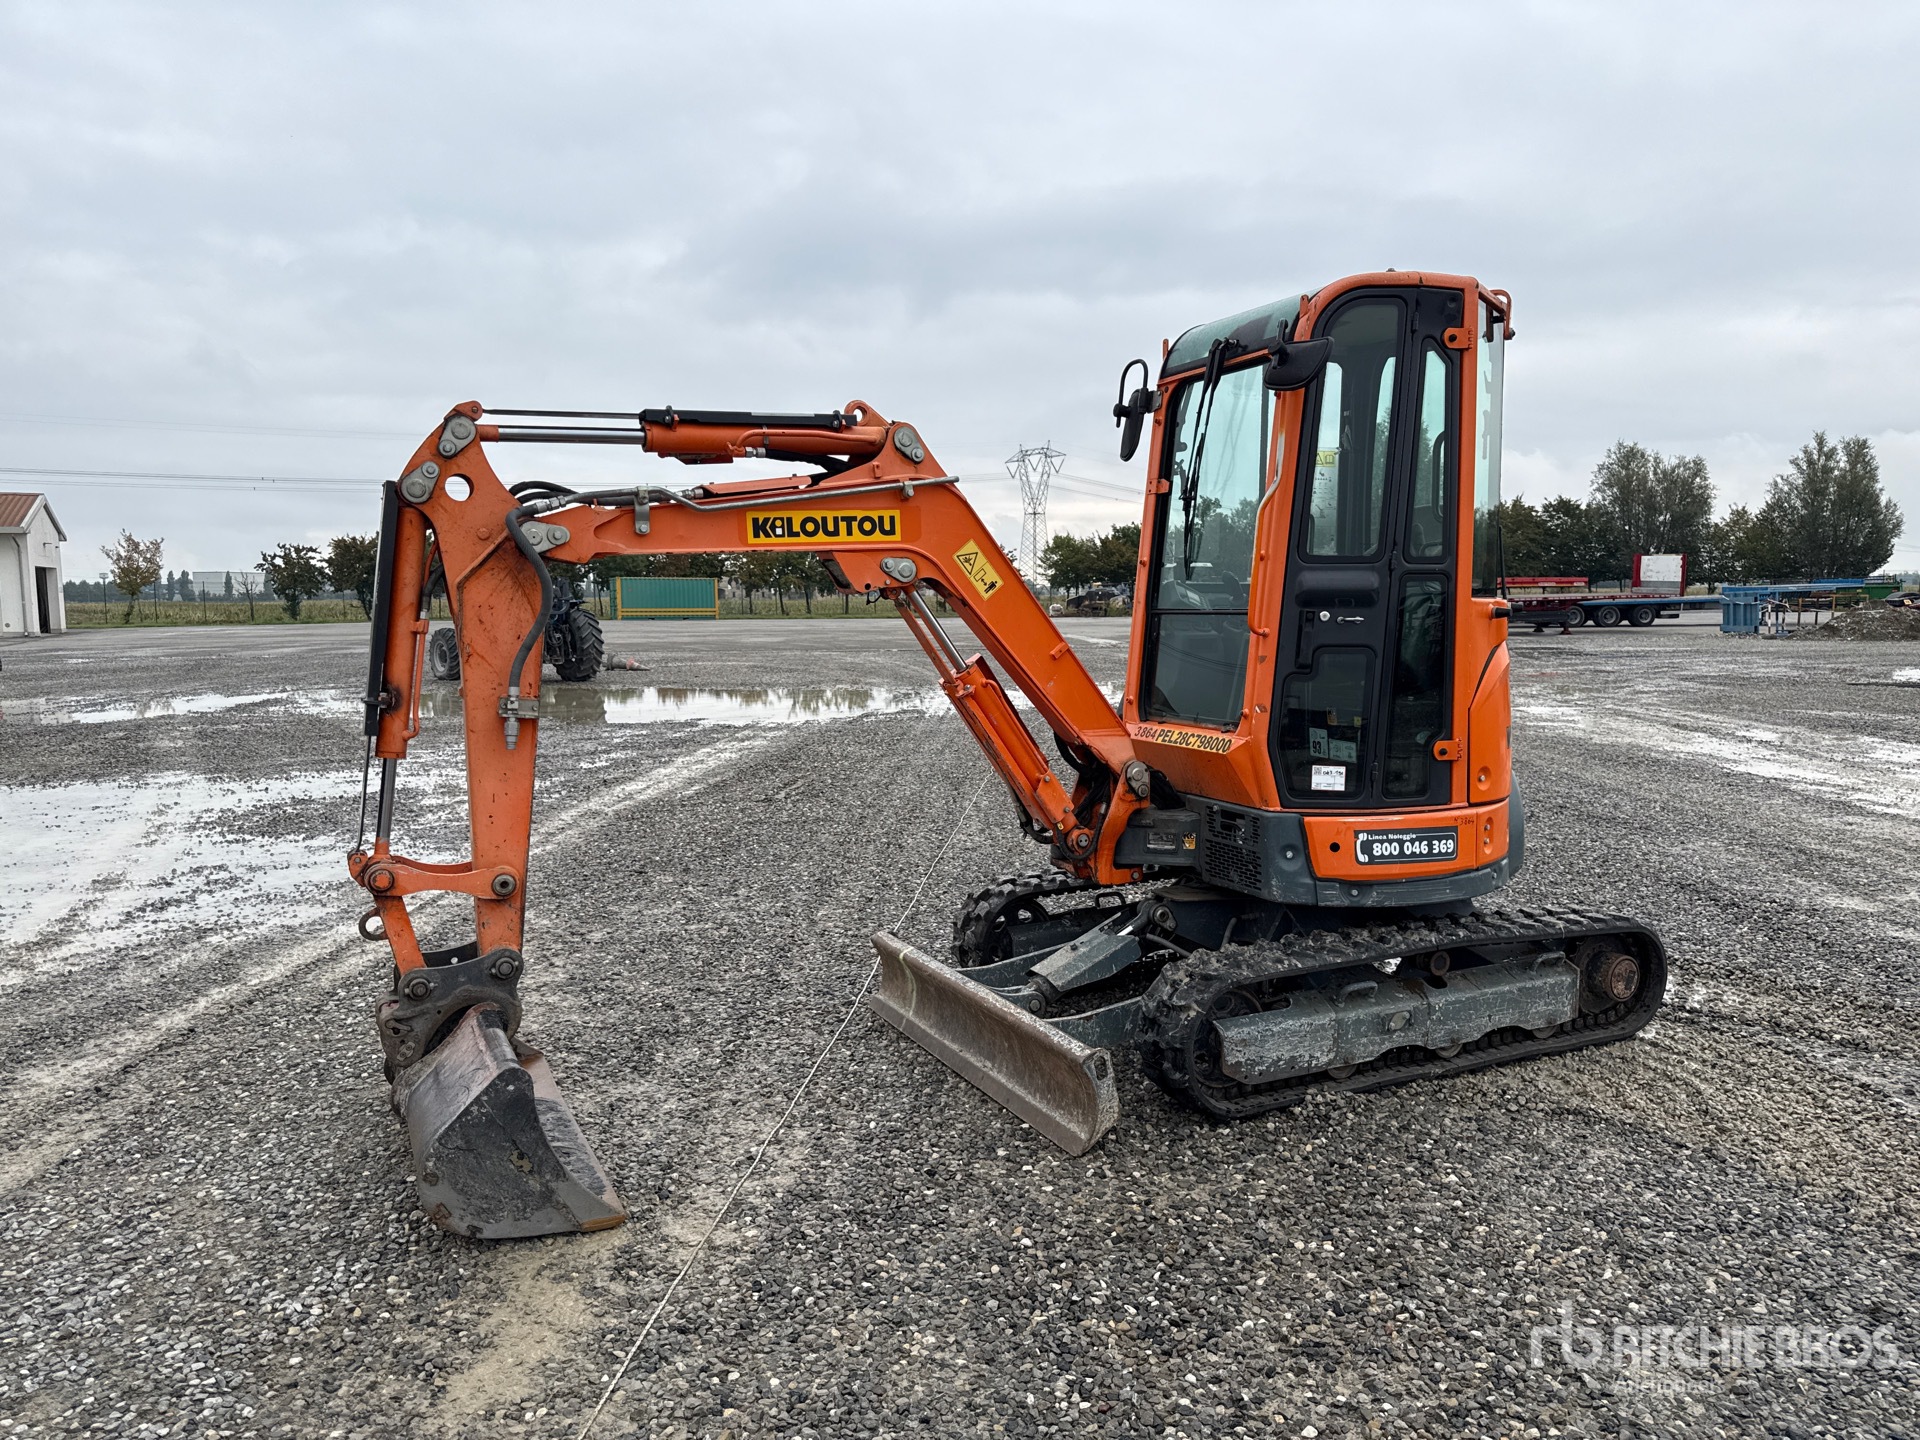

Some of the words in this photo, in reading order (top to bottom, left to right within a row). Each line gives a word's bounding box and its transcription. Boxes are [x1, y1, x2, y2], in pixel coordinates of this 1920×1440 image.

[1134, 726, 1158, 740] 3864
[1155, 728, 1233, 753] PEL28C798000
[1312, 740, 1322, 755] 93
[1388, 832, 1417, 841] Noleggio
[1372, 842, 1400, 856] 800
[1403, 840, 1429, 855] 046
[1432, 839, 1454, 854] 369
